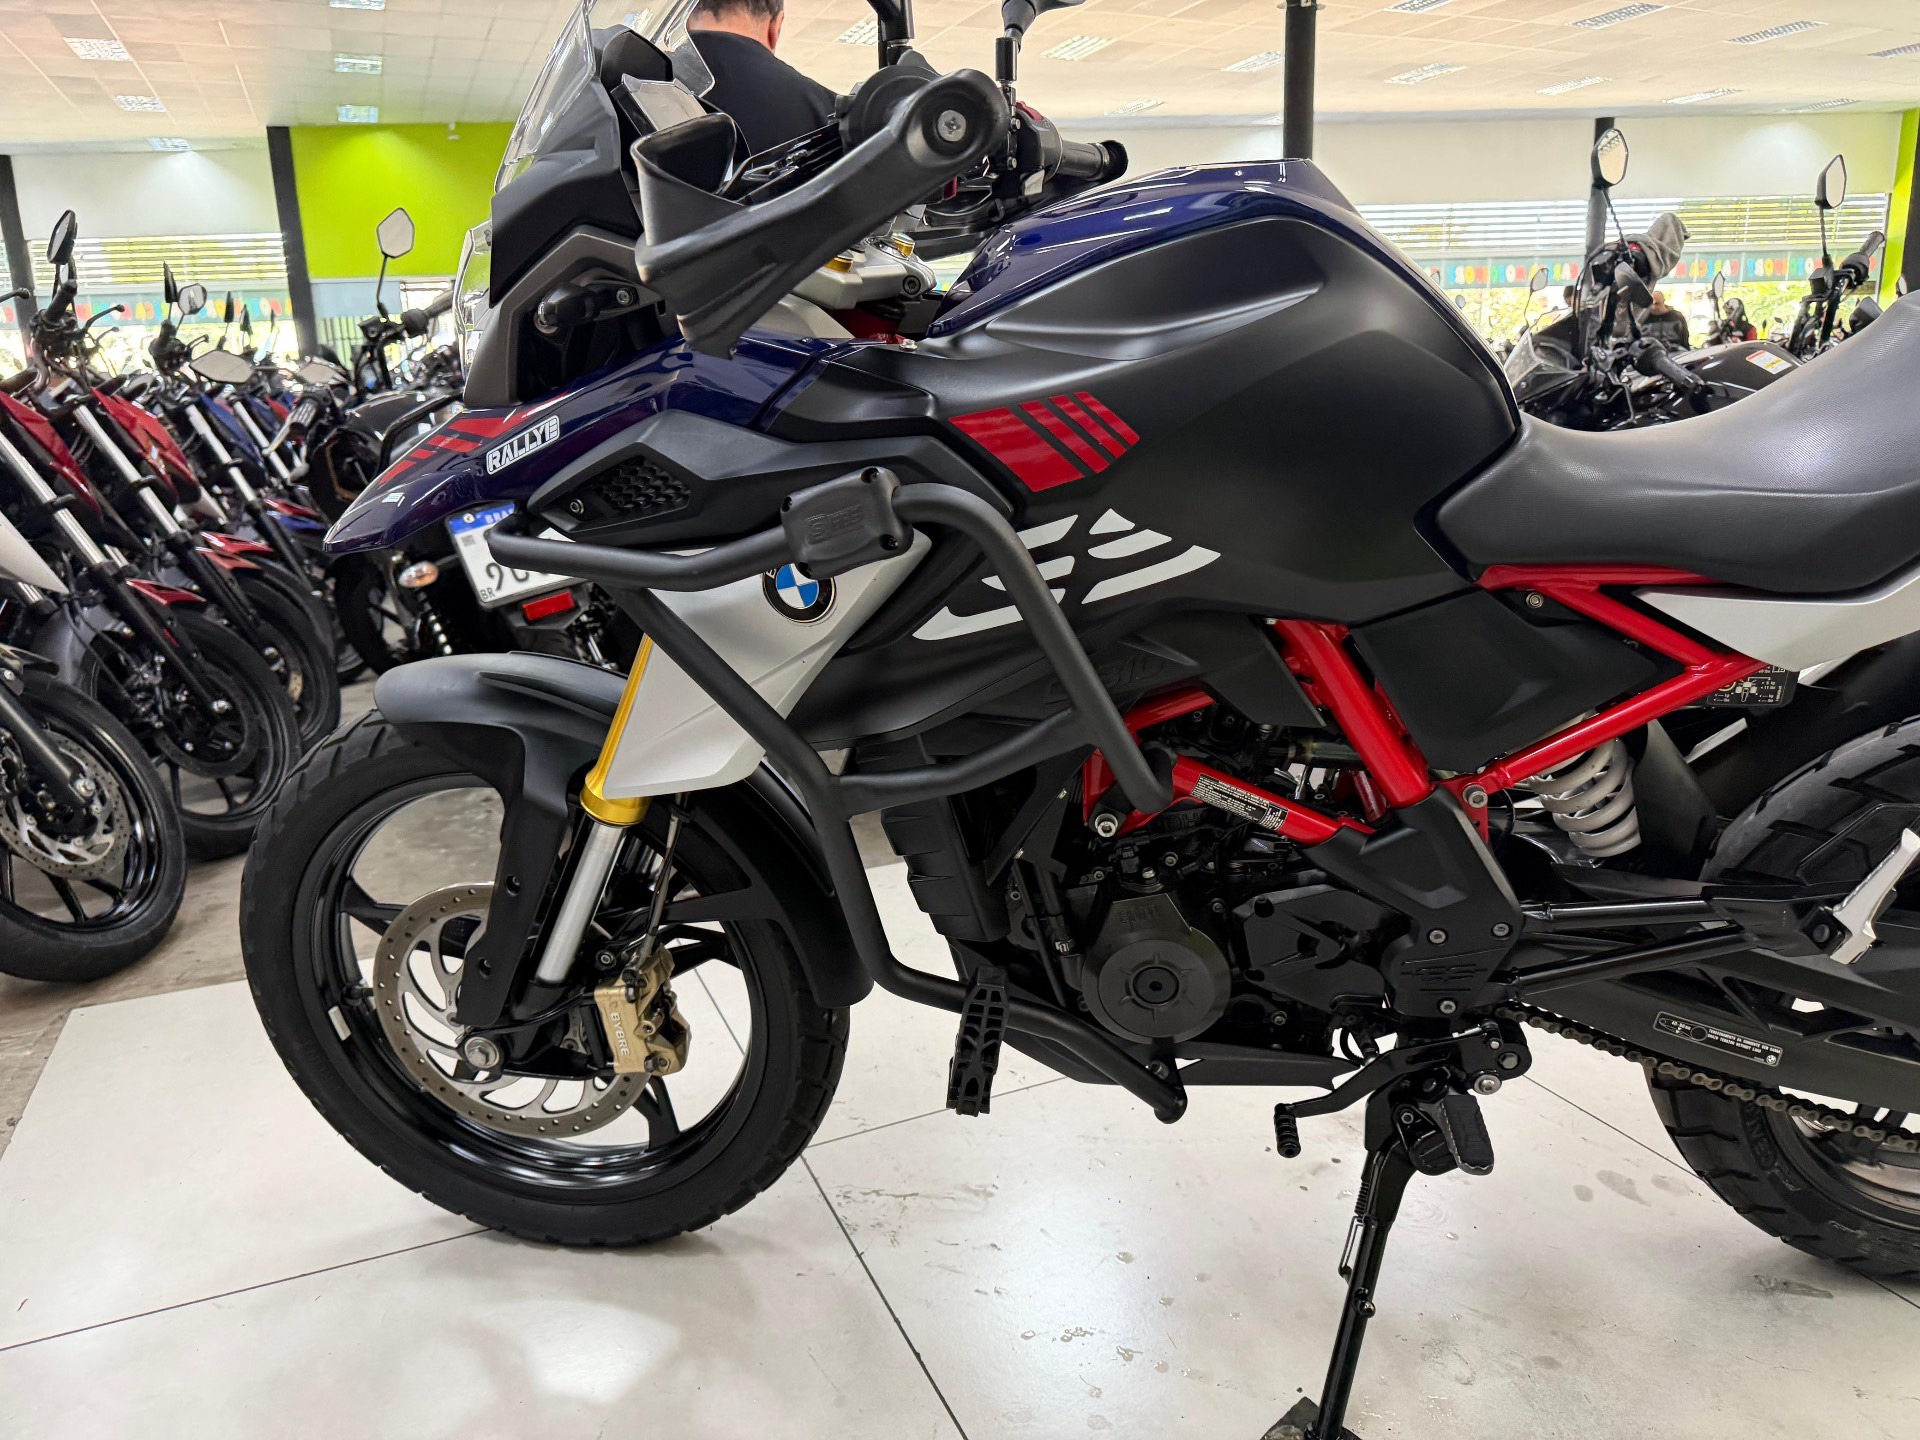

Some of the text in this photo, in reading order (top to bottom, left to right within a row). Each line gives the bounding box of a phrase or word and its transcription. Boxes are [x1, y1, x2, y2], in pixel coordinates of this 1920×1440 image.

[488, 417, 558, 471] RALLYE
[480, 587, 495, 600] BR
[611, 1012, 629, 1056] BYBRE
